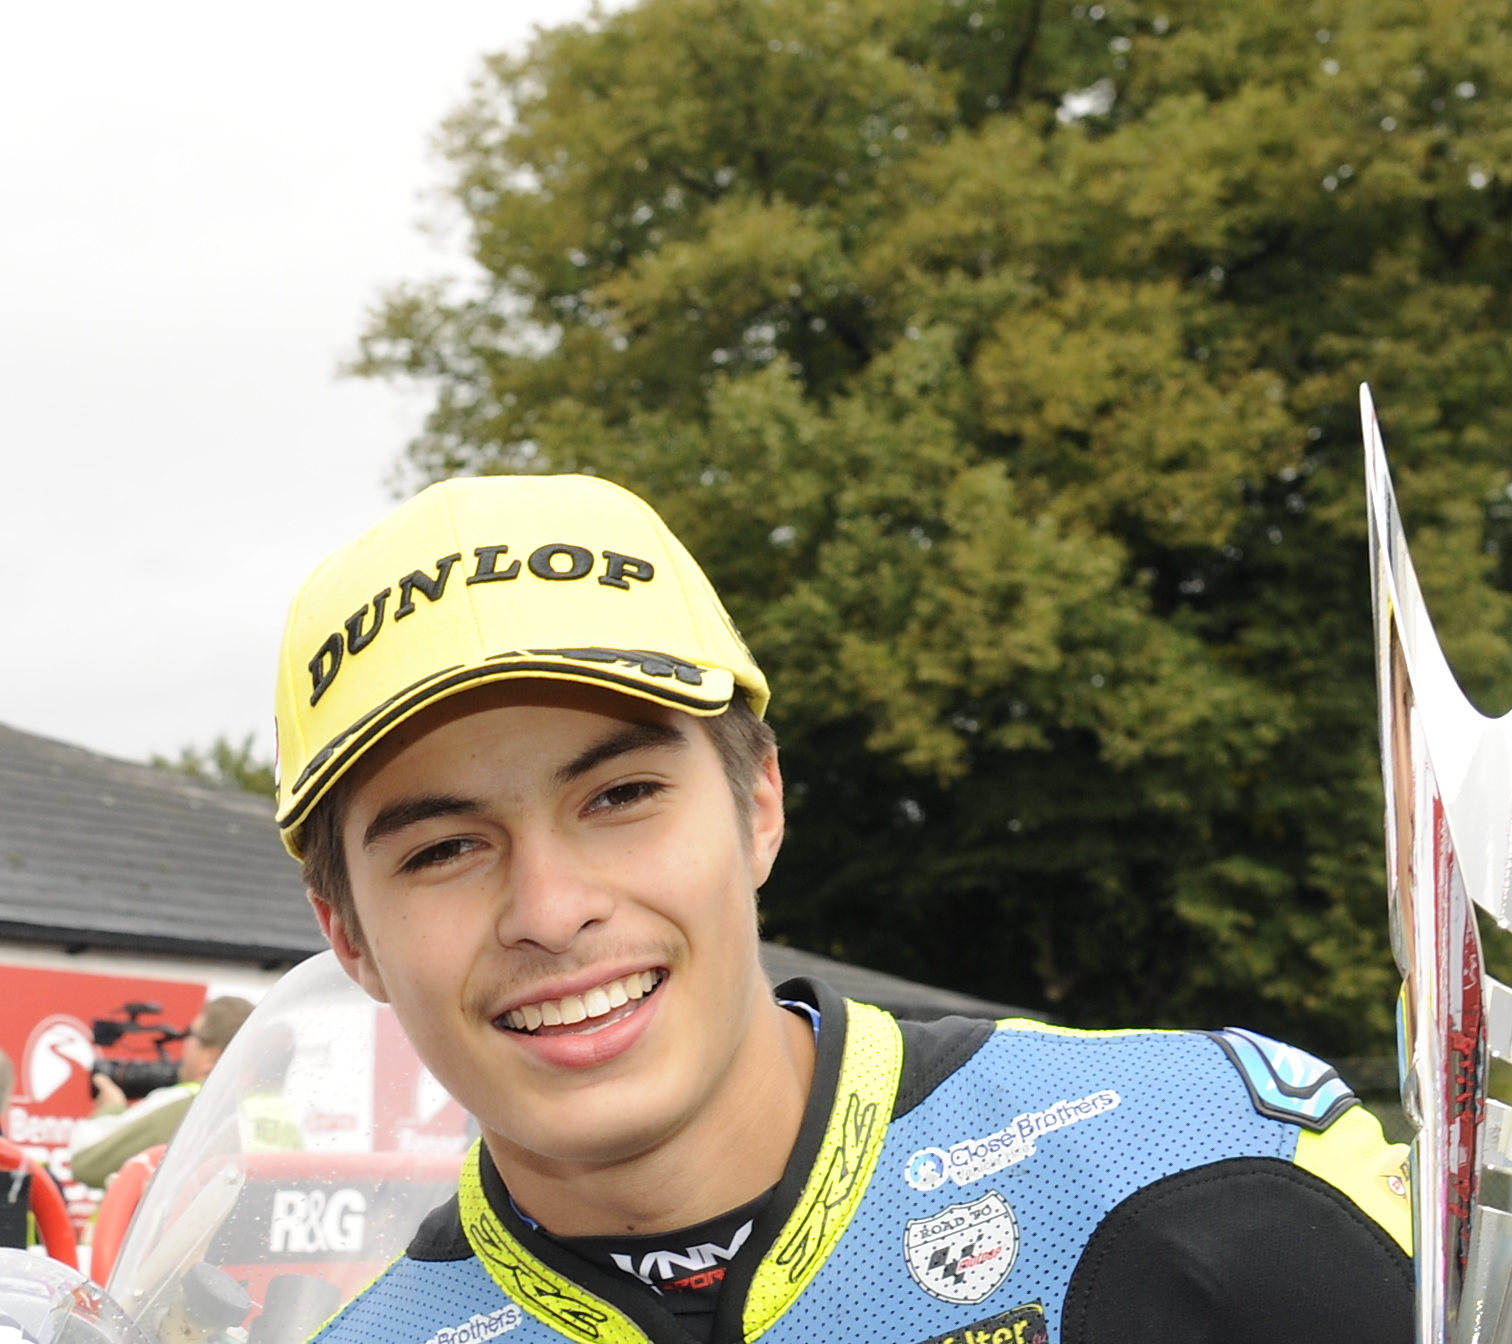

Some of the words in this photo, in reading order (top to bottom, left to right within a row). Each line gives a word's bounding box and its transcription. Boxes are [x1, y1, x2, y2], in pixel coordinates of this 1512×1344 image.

[308, 542, 655, 707] DUNLOP
[950, 1130, 1015, 1168] Close
[1015, 1091, 1114, 1141] Brothers
[270, 1188, 367, 1253] R&G
[918, 1216, 966, 1240] ROAD
[969, 1205, 993, 1220] TO
